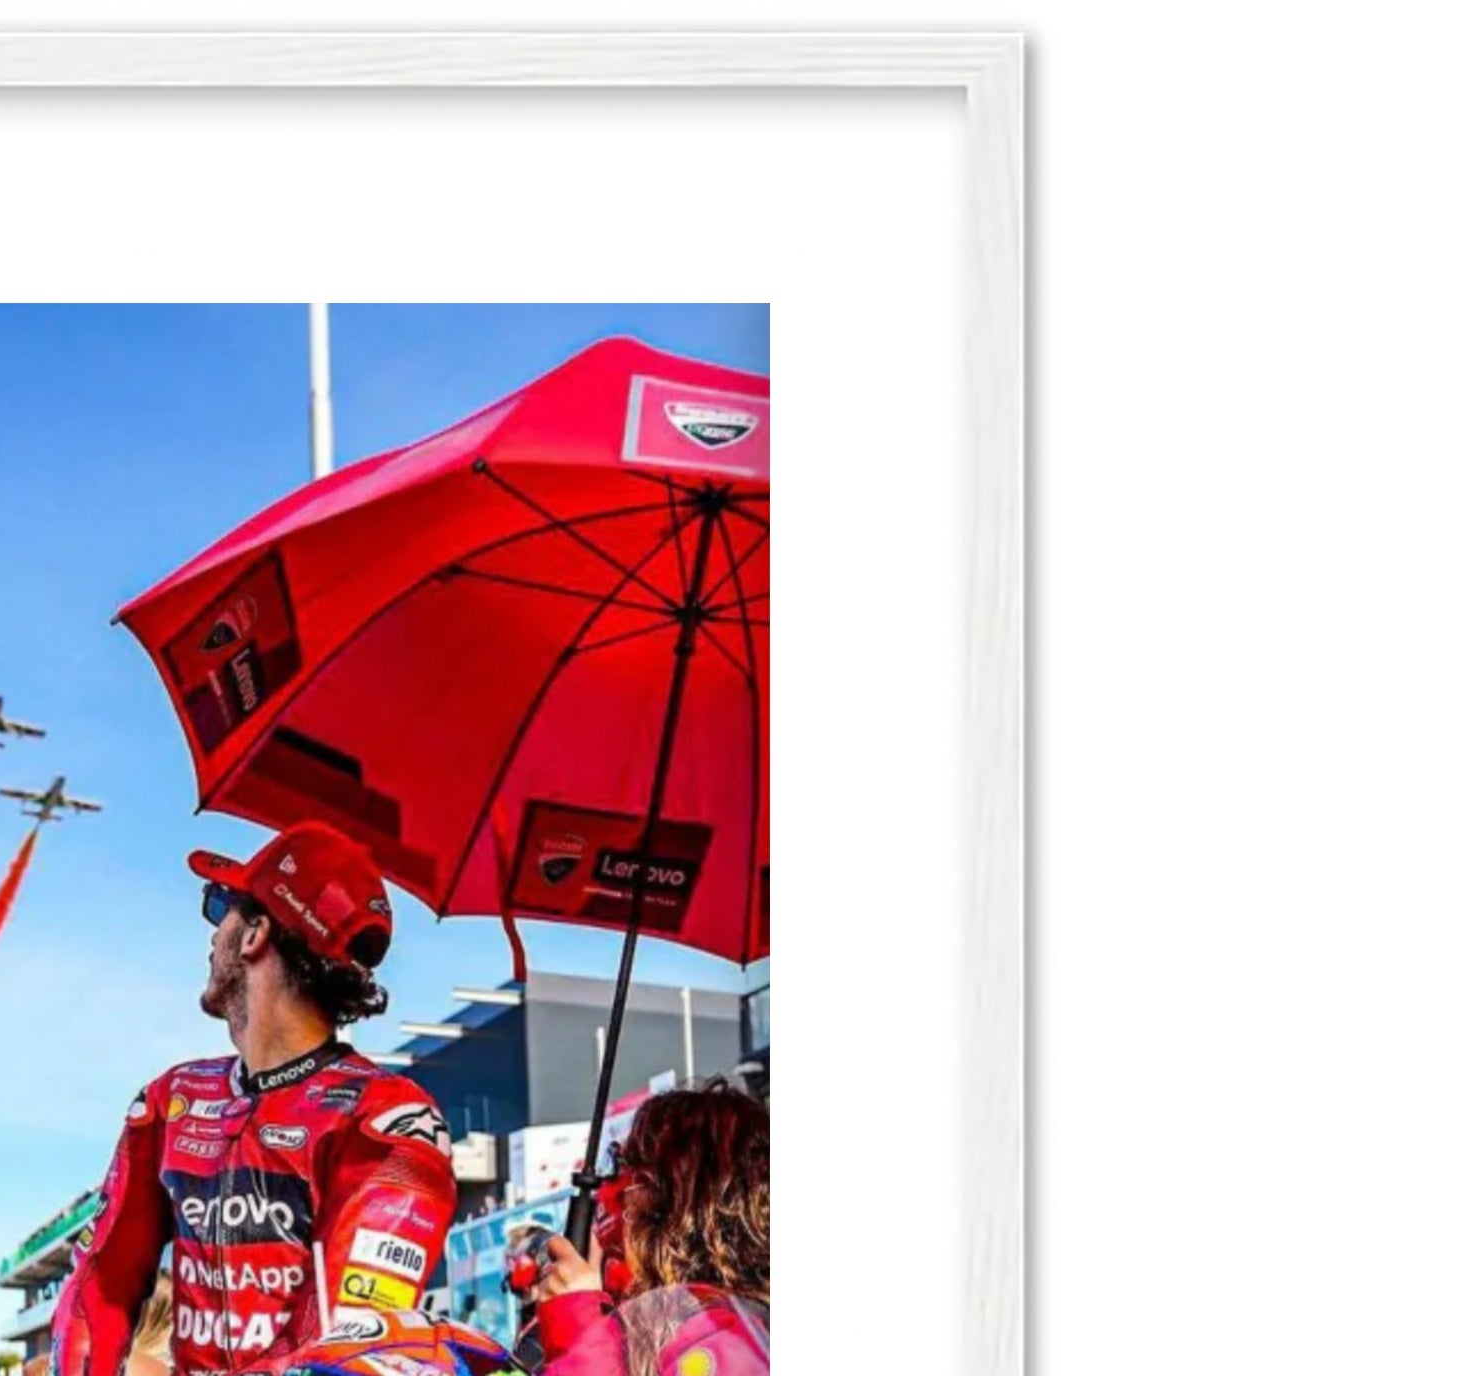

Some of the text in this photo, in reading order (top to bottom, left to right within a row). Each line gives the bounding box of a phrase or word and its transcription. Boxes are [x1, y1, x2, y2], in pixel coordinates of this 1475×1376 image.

[258, 1058, 316, 1091] Lenovo
[169, 1187, 295, 1235] enovo
[377, 1241, 422, 1272] riello
[198, 1260, 304, 1294] NetApp
